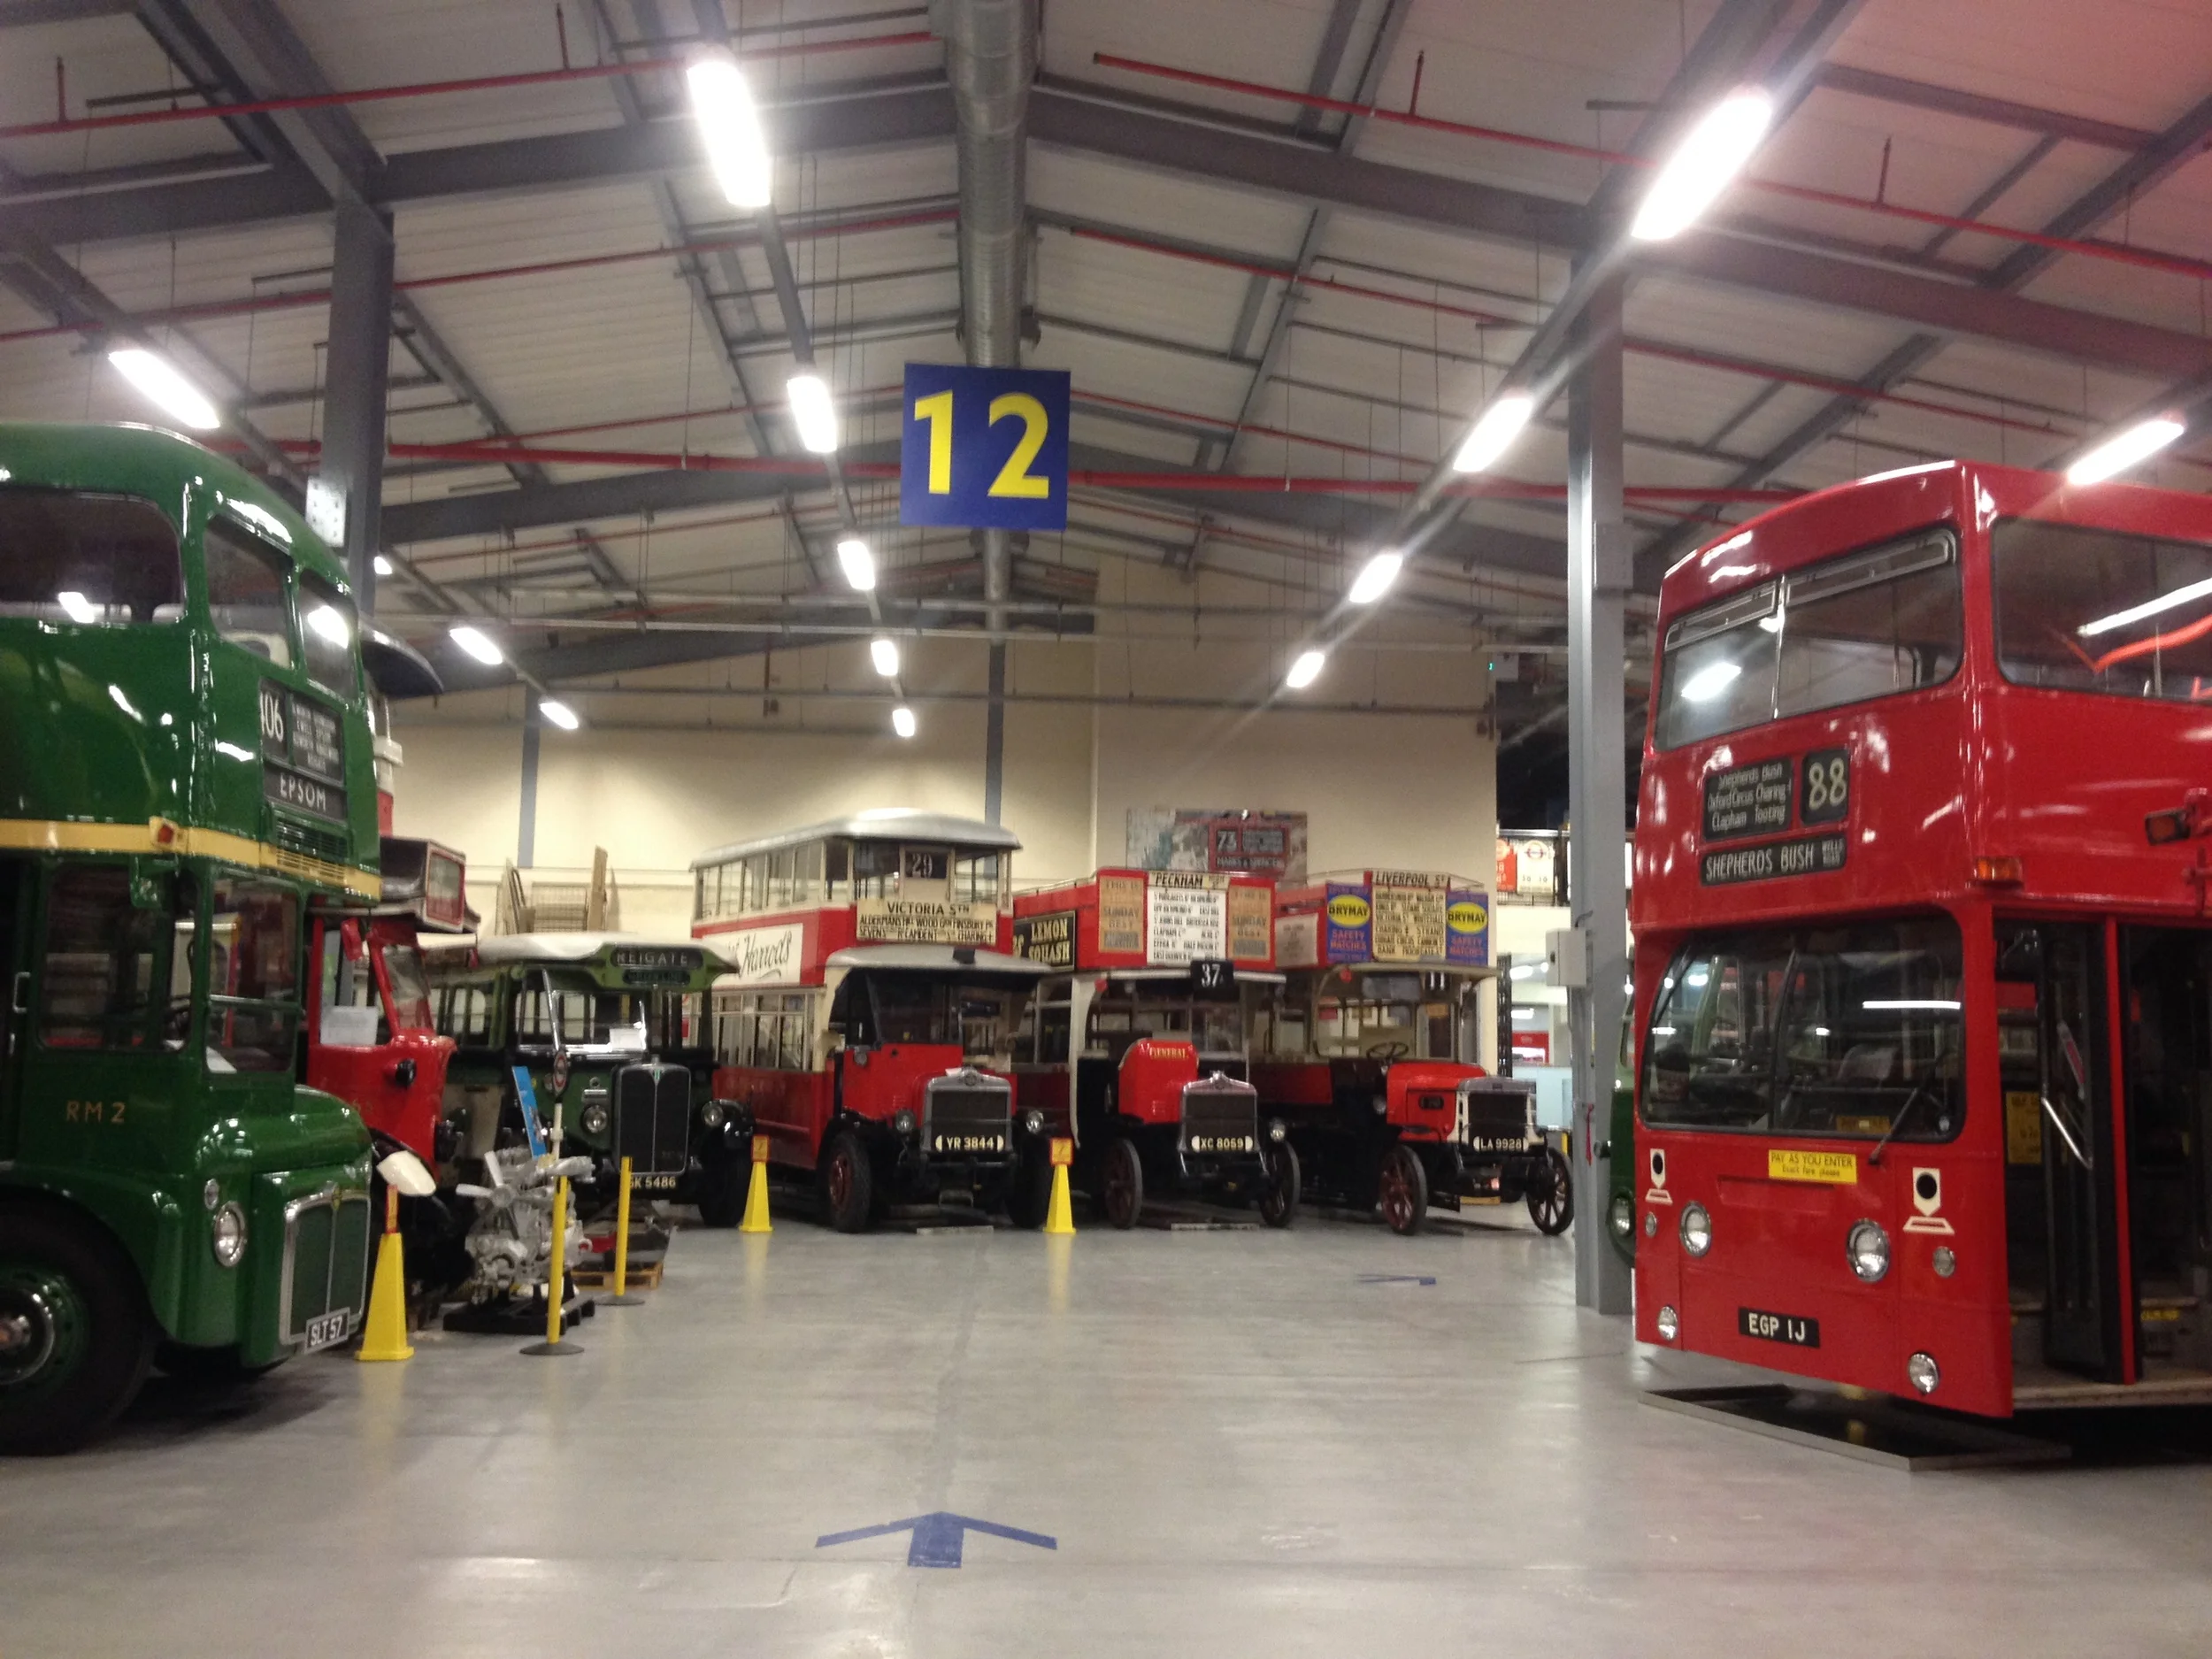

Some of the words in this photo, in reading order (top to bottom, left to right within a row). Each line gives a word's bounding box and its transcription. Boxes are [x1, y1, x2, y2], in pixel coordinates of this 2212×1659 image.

[914, 389, 1049, 499] 12
[280, 772, 309, 811] EPSOM
[1809, 757, 1847, 810] 88
[1756, 782, 1786, 804] Charing
[1712, 809, 1747, 833] Clapham
[1755, 803, 1786, 826] Tooting
[1706, 848, 1773, 882] SHEPHERDS
[1780, 841, 1815, 873] BUSH
[1155, 872, 1203, 890] PECKHAM
[1375, 870, 1429, 888] LIVERPOOL
[887, 901, 945, 915] VICTORIA
[1328, 903, 1368, 917] BRYMAY
[1448, 910, 1485, 924] BRYMAY
[1031, 917, 1068, 944] LEMON
[1332, 928, 1365, 941] SAFETY
[617, 952, 688, 967] REIGATE
[741, 929, 793, 976] Harrods
[1028, 940, 1071, 964] SQUASH
[946, 1136, 962, 1151] YR
[964, 1136, 995, 1151] 3844
[1201, 1137, 1214, 1150] XC
[1480, 1138, 1494, 1150] LA
[1495, 1138, 1522, 1150] 9928
[1771, 1152, 1786, 1164] PAY
[1789, 1153, 1800, 1164] AS
[1802, 1154, 1822, 1166] YOU
[1824, 1156, 1854, 1168] ENTER
[645, 1176, 676, 1189] 5486
[311, 1319, 329, 1346] SLT
[329, 1315, 343, 1340] 57
[1748, 1312, 1780, 1339] EGP
